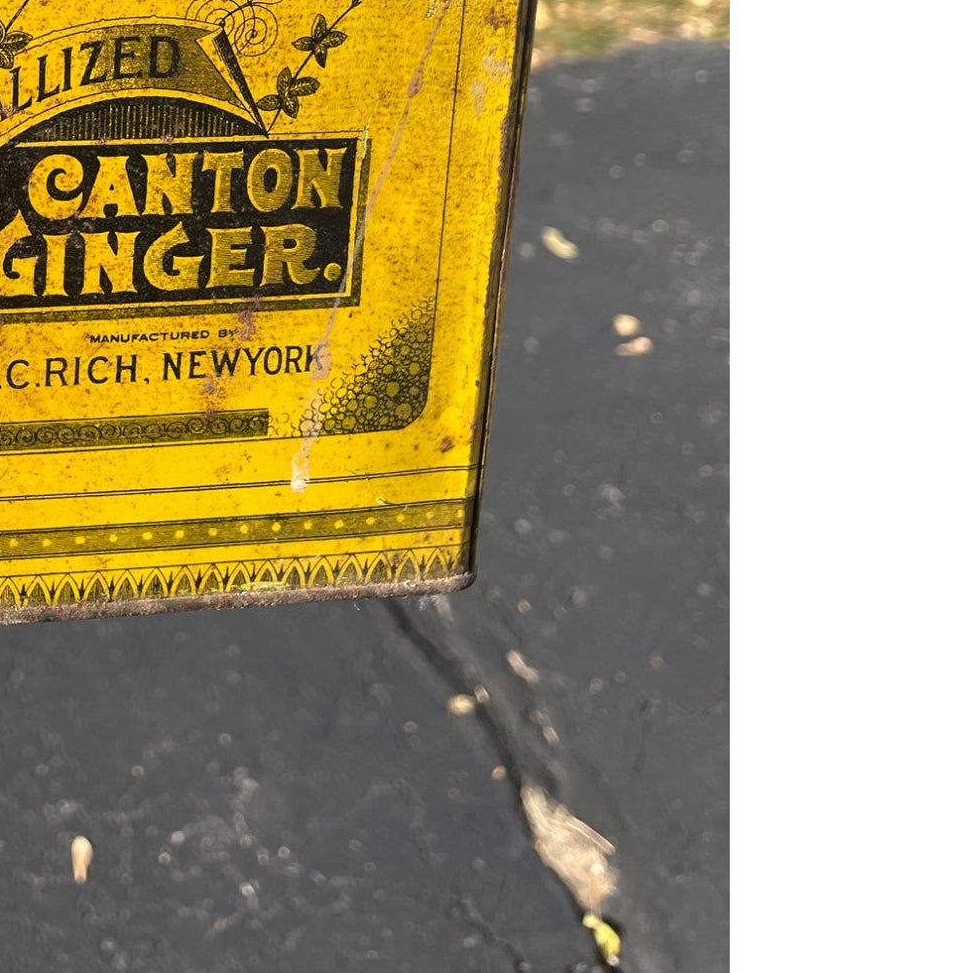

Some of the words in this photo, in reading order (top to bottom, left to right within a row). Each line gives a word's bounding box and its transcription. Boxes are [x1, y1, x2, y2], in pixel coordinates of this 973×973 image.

[27, 147, 348, 220] CANTON
[89, 330, 209, 344] MANUFACTURED
[217, 329, 238, 338] BY
